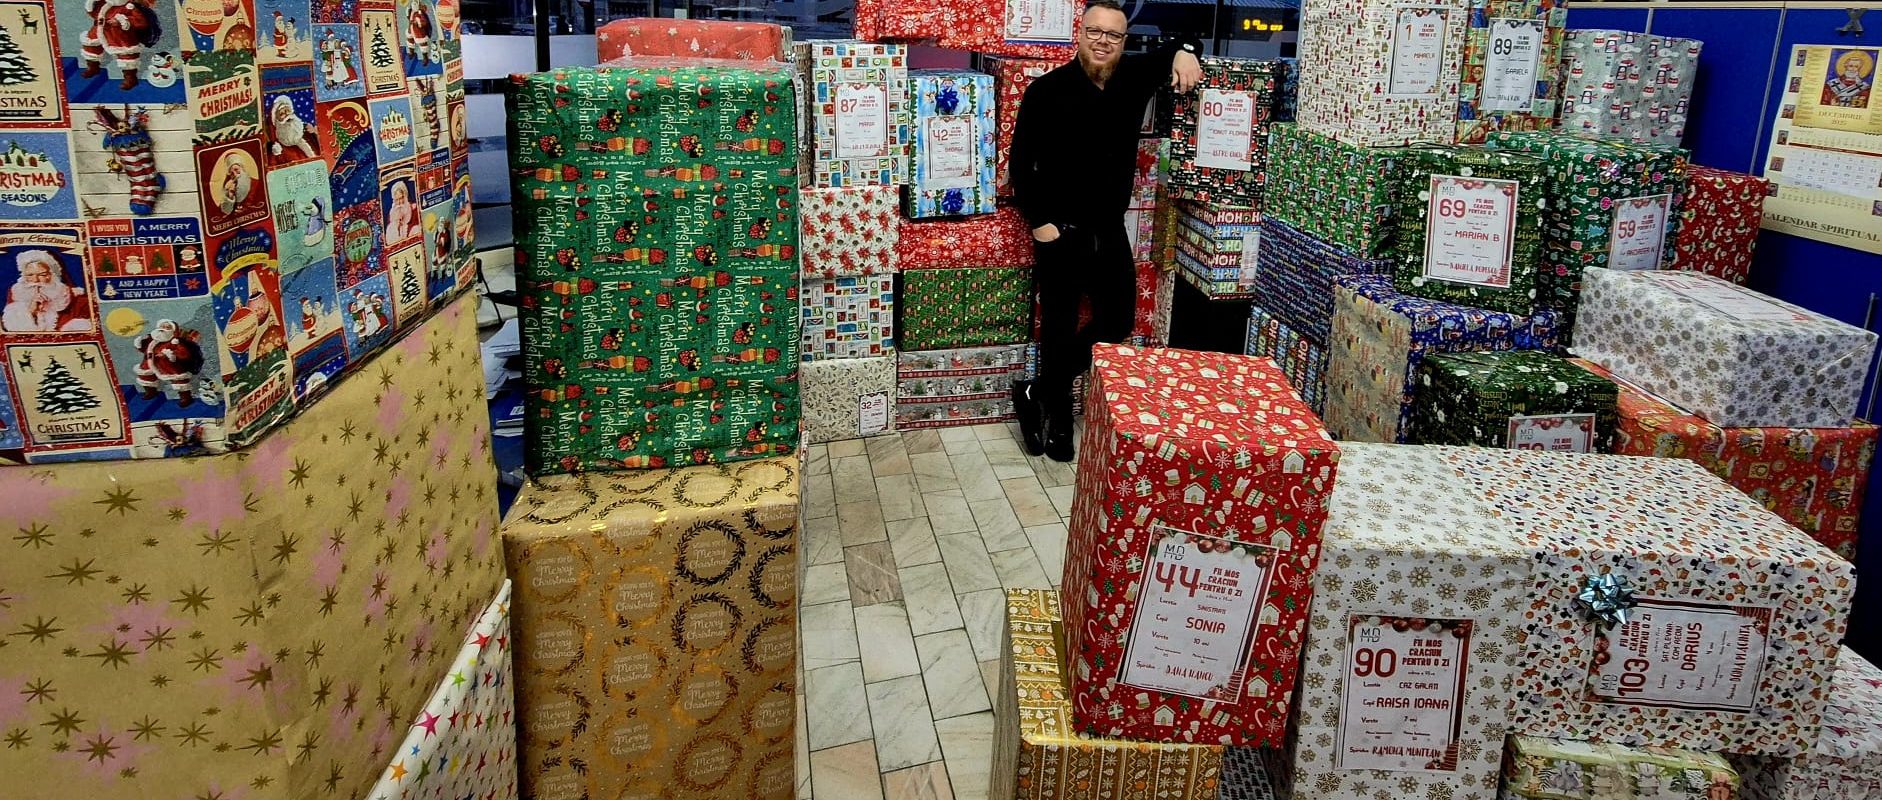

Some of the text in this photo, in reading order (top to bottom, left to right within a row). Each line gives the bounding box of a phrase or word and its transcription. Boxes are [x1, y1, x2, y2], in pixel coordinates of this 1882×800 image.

[1019, 16, 1032, 34] 40
[1405, 24, 1412, 41] 1
[1493, 38, 1513, 56] 89
[197, 77, 241, 99] MERRY
[200, 88, 253, 119] CHRISTMAS!
[678, 82, 696, 124] Merry
[719, 75, 740, 140] Christmas
[840, 98, 858, 113] 87
[1203, 101, 1223, 117] 80
[659, 95, 681, 164] Christmas
[932, 129, 949, 141] 42
[732, 182, 750, 249] Christmas
[1439, 198, 1467, 219] 69
[151, 222, 191, 231] MERRY
[595, 184, 618, 254] Christmas
[1762, 211, 1881, 242] CALENDAR SPIRITUAL
[1454, 230, 1489, 241] MARIAN
[1617, 220, 1636, 239] 59
[94, 234, 197, 247] CHRISTMAS
[600, 281, 618, 322] Merry
[580, 295, 602, 360] Christmas
[677, 300, 694, 341] Merry
[717, 288, 736, 354] Christmas
[861, 401, 872, 410] 32
[37, 417, 111, 435] CHRISTMAS
[1155, 561, 1201, 598] 44
[1207, 575, 1239, 588] CRACIUN
[1224, 569, 1240, 579] MOS
[1199, 582, 1227, 594] PENTRU
[1234, 589, 1243, 597] ZI
[1185, 616, 1226, 634] SONIA
[1642, 613, 1652, 622] ZI
[1425, 639, 1442, 647] MOS
[1629, 620, 1641, 652] CRACIUN
[1638, 630, 1650, 657] PENTRU
[1409, 648, 1442, 657] CRACIUN
[1672, 646, 1681, 661] COM
[1681, 622, 1702, 671] DARIUS
[1354, 647, 1397, 678] 90
[1402, 657, 1431, 666] PENTRU
[1441, 658, 1450, 666] ZI
[1661, 651, 1670, 662] SAT
[1398, 681, 1412, 689] CAZ
[1617, 658, 1650, 697] 103
[1376, 696, 1410, 709] RAISA
[1413, 697, 1450, 710] IOANA
